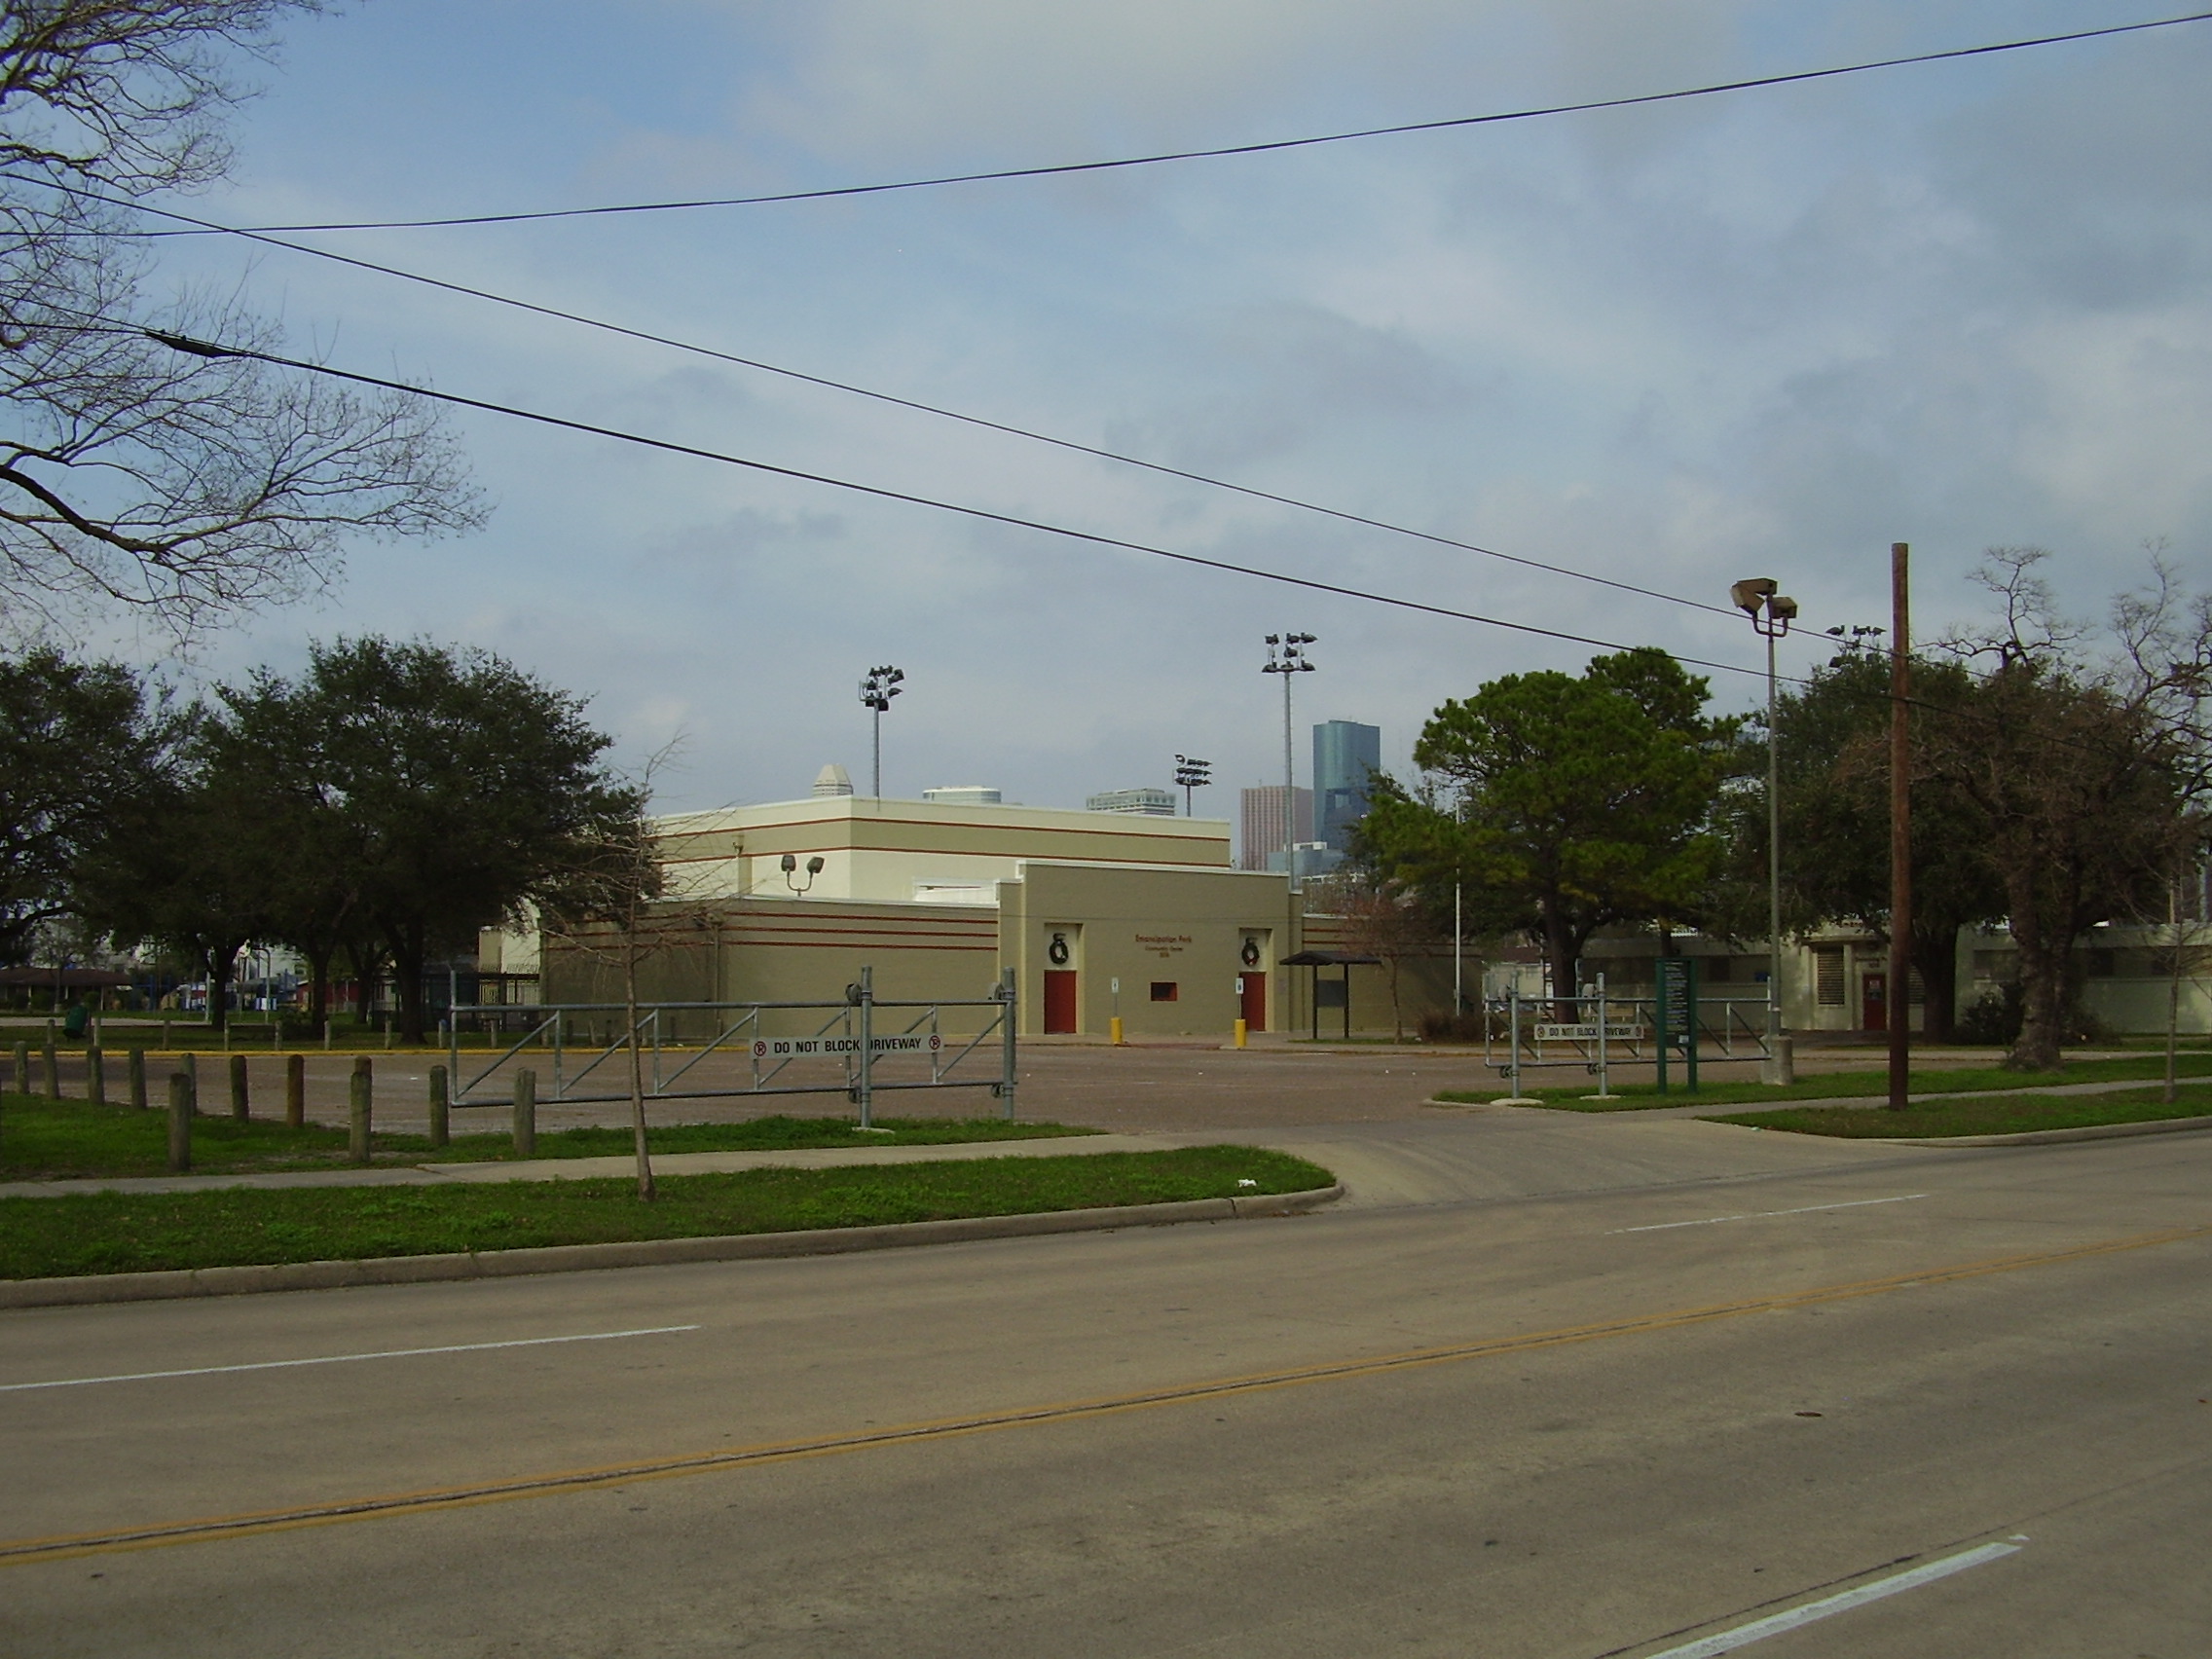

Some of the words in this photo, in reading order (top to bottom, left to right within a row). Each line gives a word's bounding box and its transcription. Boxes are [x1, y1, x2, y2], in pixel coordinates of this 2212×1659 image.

[1549, 1027, 1559, 1036] DO
[1577, 1027, 1597, 1036] BLOCK
[774, 1041, 791, 1054] DO
[795, 1041, 819, 1053] NOT
[825, 1039, 861, 1052] BLOCK
